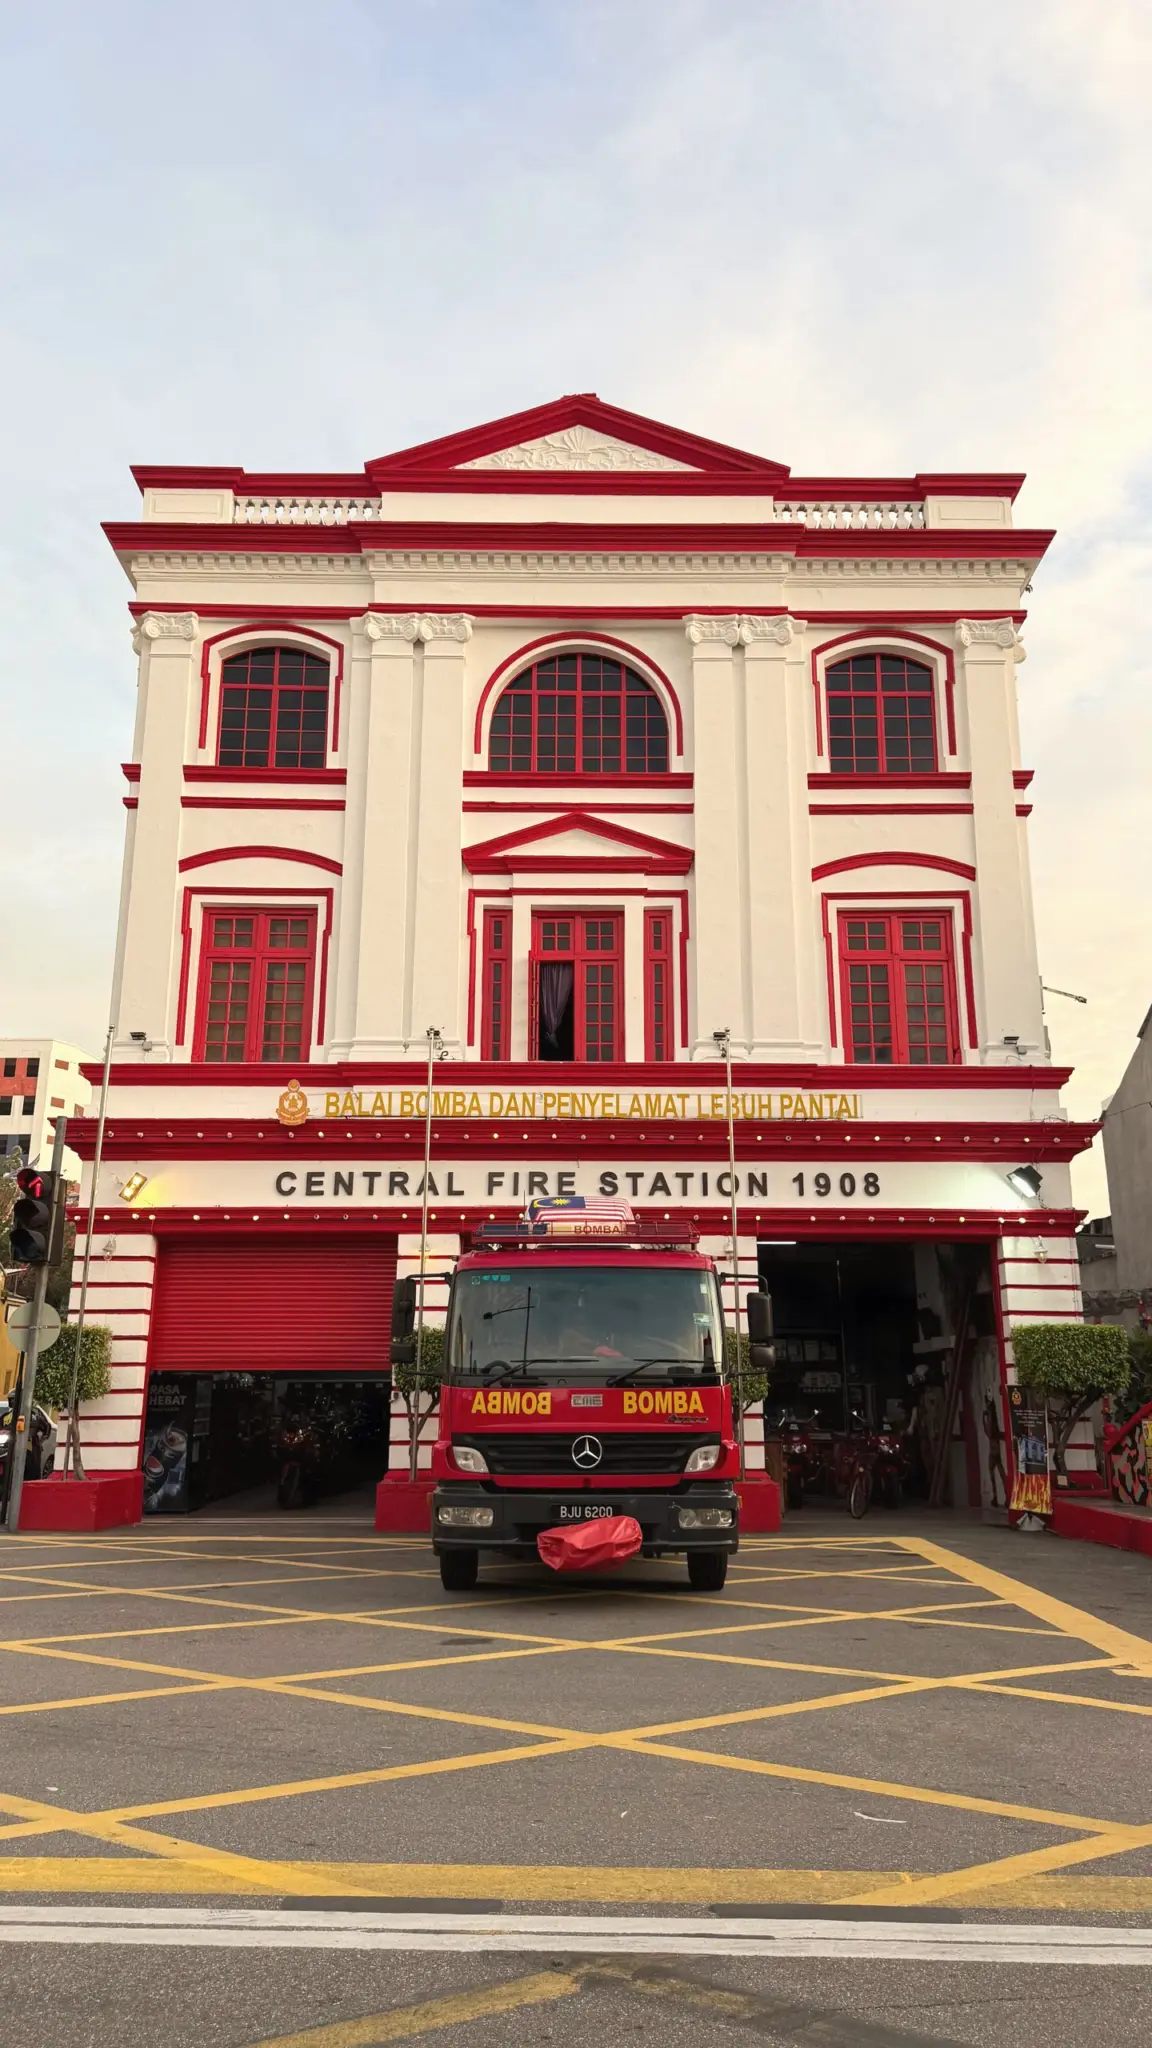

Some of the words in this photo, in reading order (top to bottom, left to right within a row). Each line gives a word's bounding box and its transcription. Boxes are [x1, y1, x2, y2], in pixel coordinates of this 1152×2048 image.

[325, 1091, 393, 1117] BALAI
[400, 1091, 482, 1117] BOMBA
[489, 1092, 537, 1117] DAN
[544, 1092, 690, 1118] PENYELAMAT
[697, 1093, 773, 1119] LEBUH
[780, 1093, 858, 1119] PANTAI
[275, 1171, 465, 1197] CENTRAL
[487, 1171, 576, 1196] FIRE
[599, 1171, 768, 1197] STATION
[792, 1172, 881, 1197] 1908
[574, 1225, 620, 1234] BOMBA
[150, 1384, 180, 1395] RASA
[623, 1391, 704, 1414] BOMBA
[560, 1506, 582, 1518] BJU
